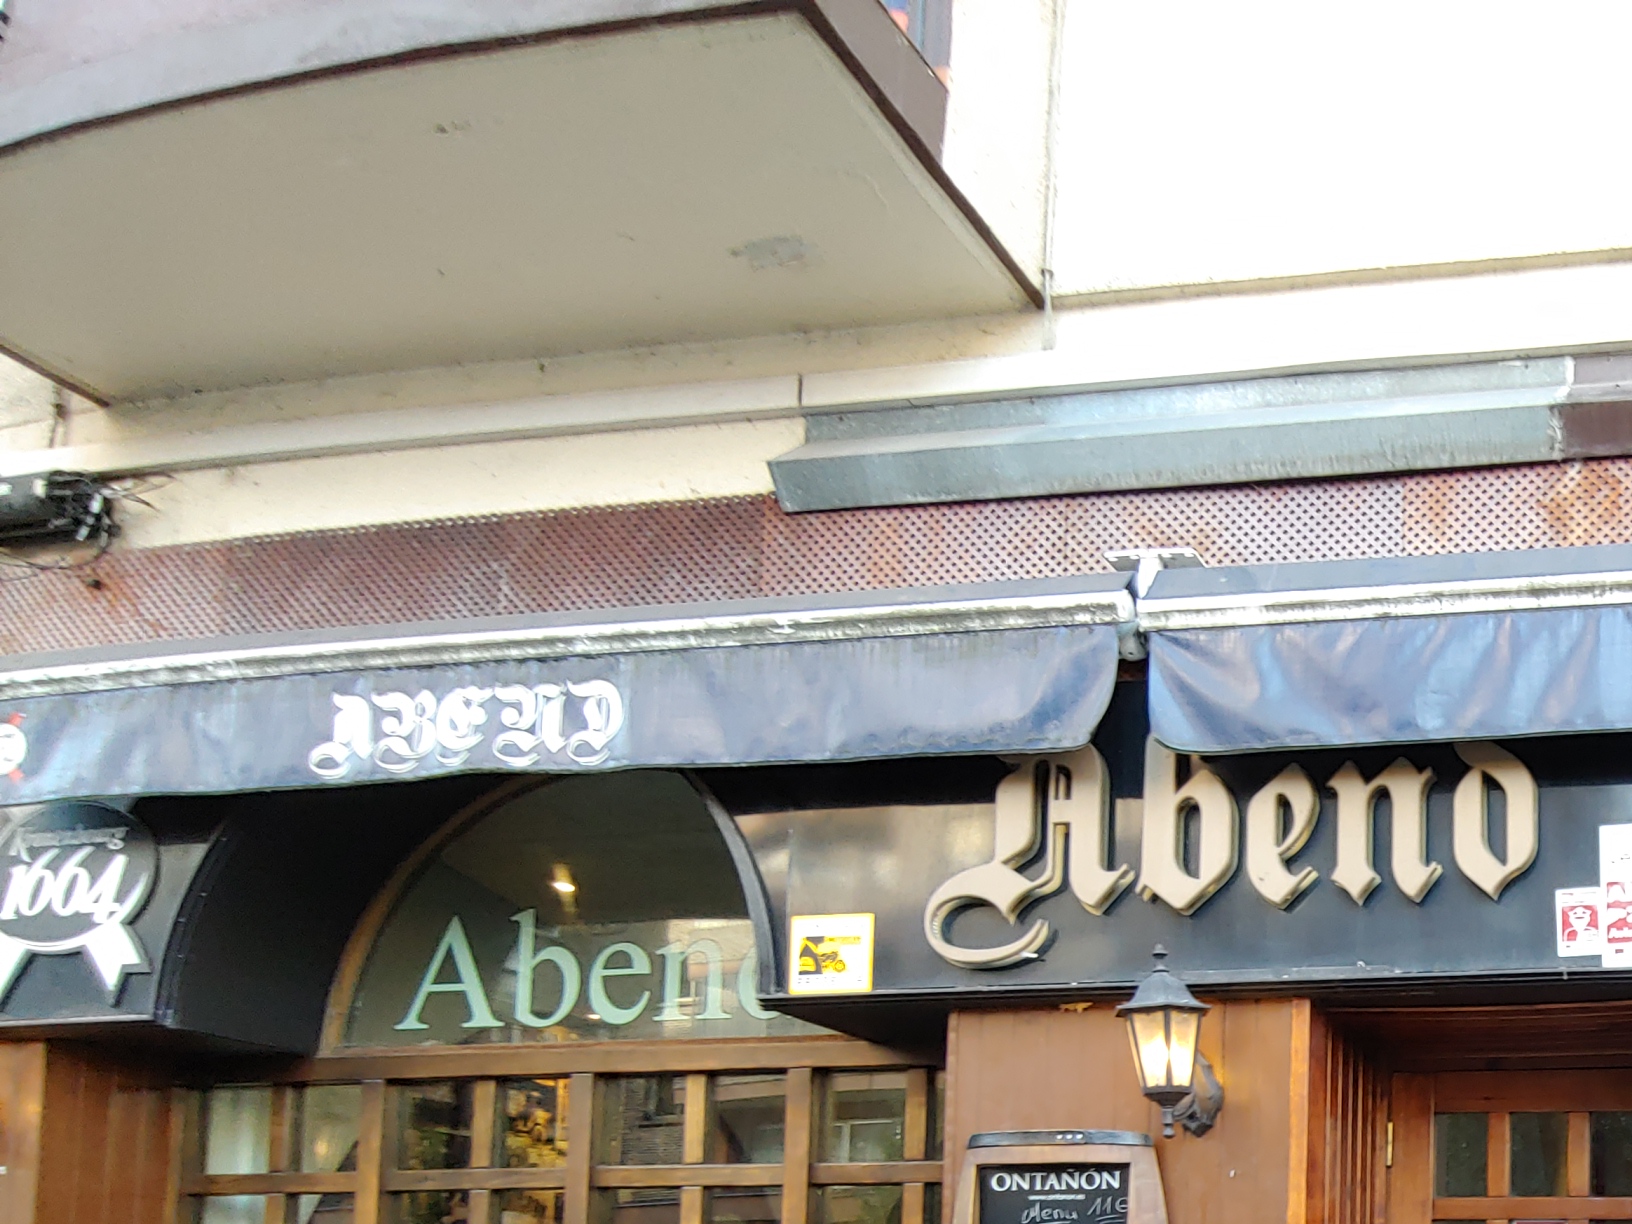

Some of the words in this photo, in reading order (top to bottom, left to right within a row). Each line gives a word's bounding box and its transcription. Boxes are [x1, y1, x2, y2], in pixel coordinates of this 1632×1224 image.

[308, 678, 624, 781] ABEND
[0, 845, 130, 925] 1664
[924, 738, 1538, 969] Abend
[990, 1168, 1122, 1192] ONTAÑÓN
